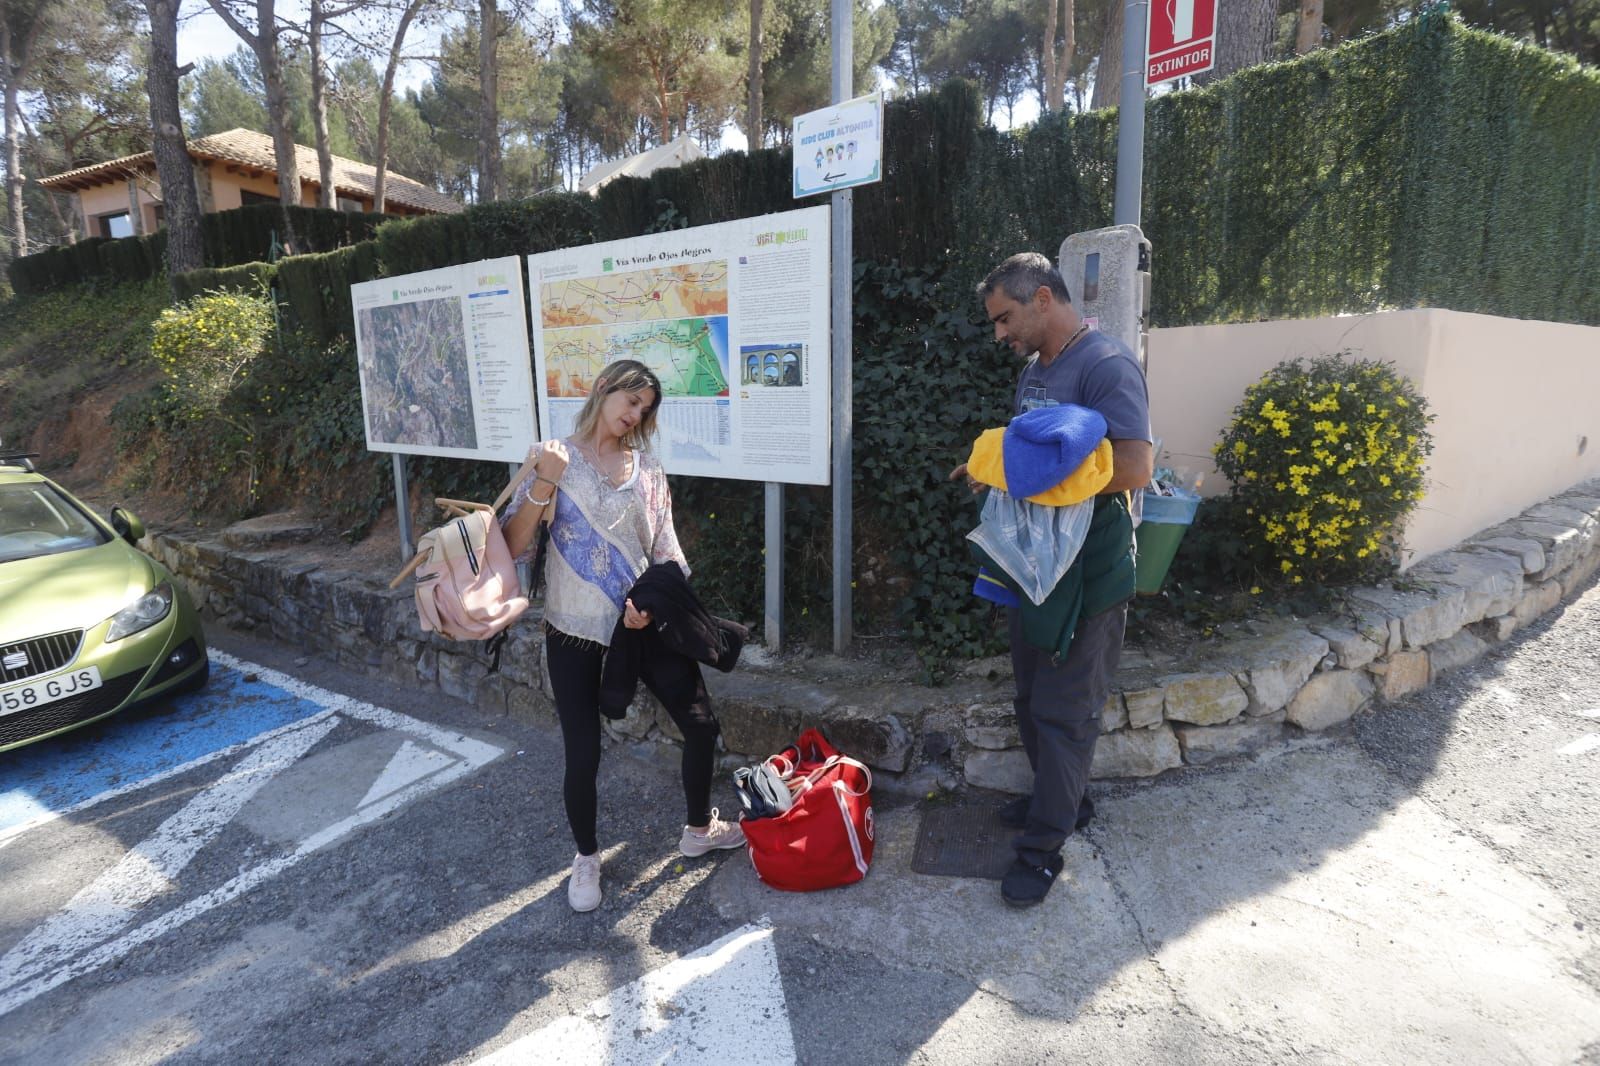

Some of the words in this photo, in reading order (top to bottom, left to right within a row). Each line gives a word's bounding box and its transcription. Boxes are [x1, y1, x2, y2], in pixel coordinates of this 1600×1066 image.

[1149, 49, 1209, 77] EXTINTOR
[817, 129, 835, 141] CLUB
[836, 120, 873, 135] ALTOMIRA
[632, 253, 657, 265] Verde
[659, 251, 678, 262] Ojos
[681, 246, 712, 258] Negros
[0, 687, 37, 711] 58
[46, 671, 93, 698] GJS
